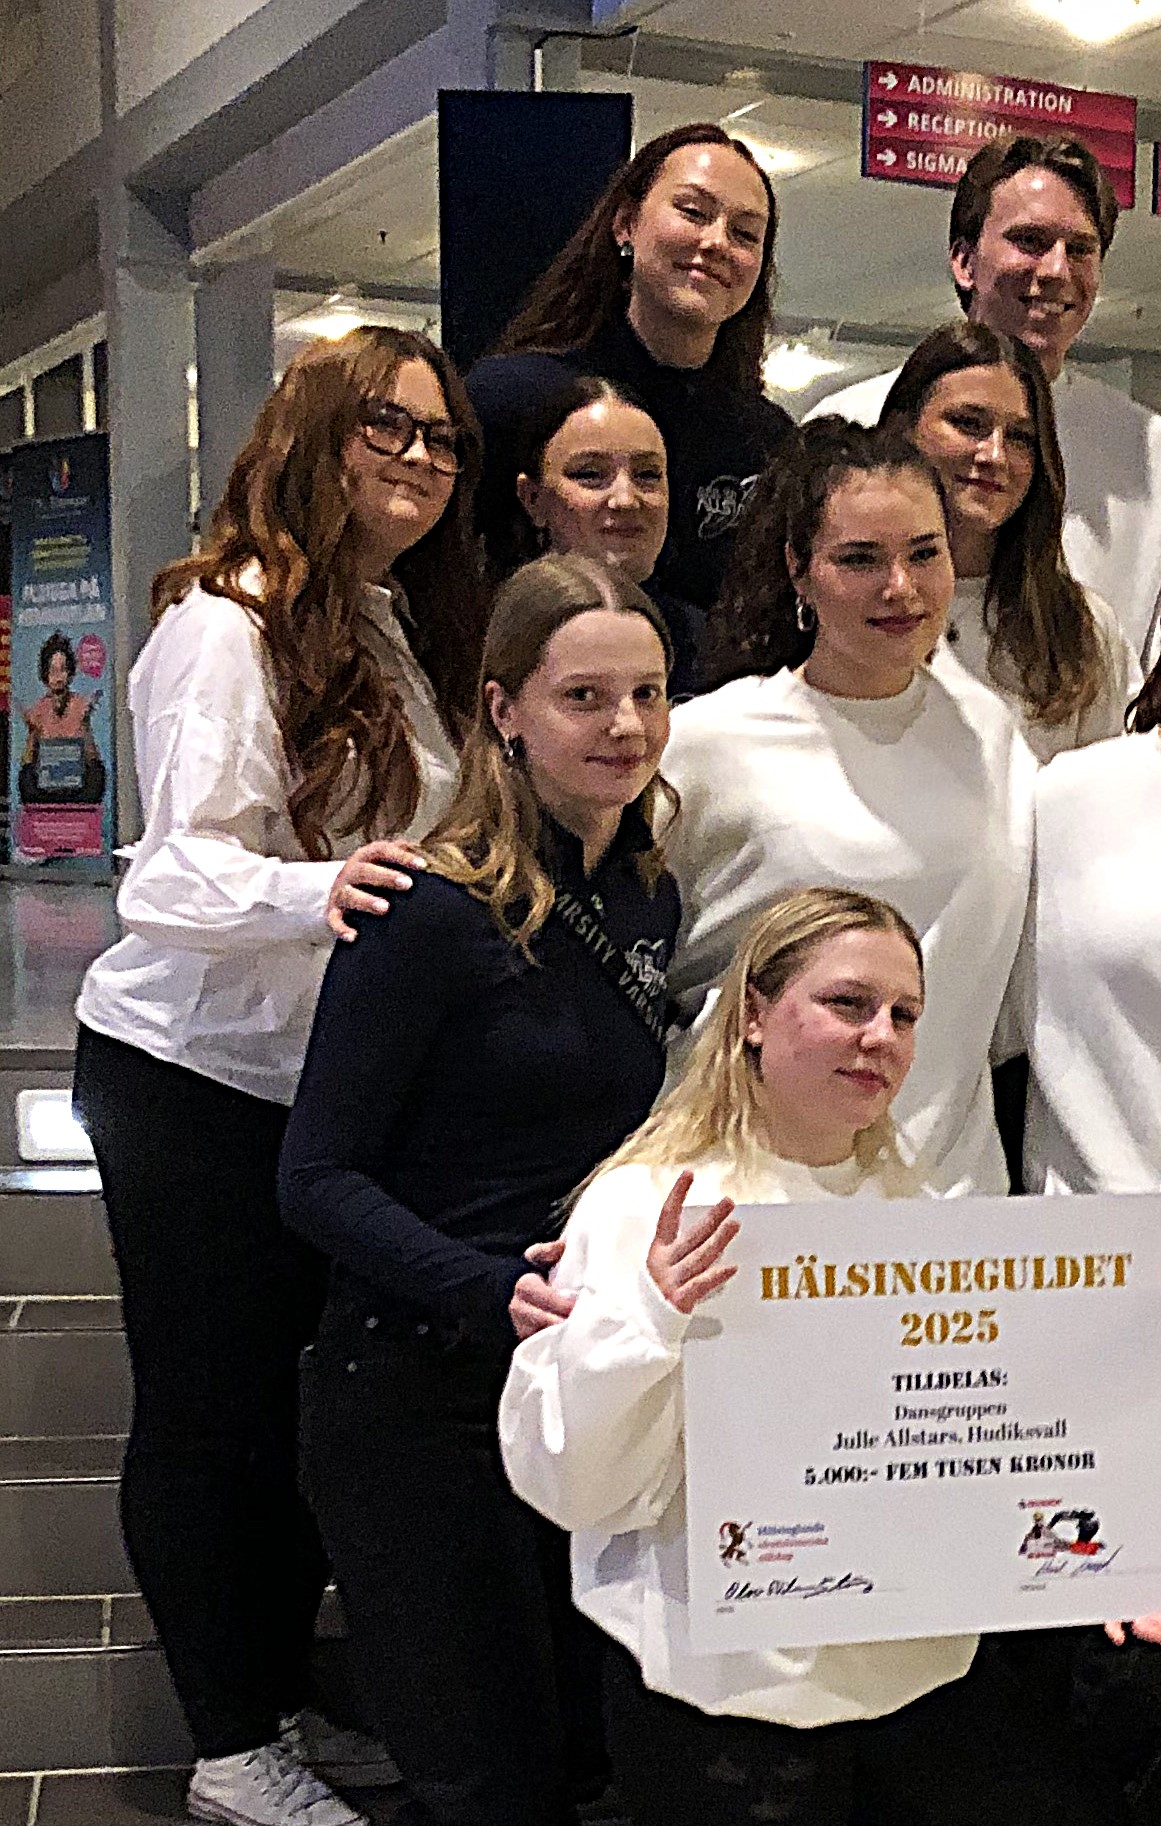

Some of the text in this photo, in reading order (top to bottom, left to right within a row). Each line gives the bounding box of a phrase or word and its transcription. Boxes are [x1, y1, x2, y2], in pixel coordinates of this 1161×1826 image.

[907, 74, 1073, 114] ADMINISTRATION
[760, 1252, 1134, 1301] HÄLSINGEGULDET
[900, 1309, 1000, 1348] 2025
[891, 1368, 1009, 1393] TILLDELAS:
[894, 1402, 1008, 1424] Dansgruppen
[967, 1418, 1068, 1444] Hudiksvall
[885, 1460, 929, 1482] FEM
[934, 1457, 1002, 1479] TUSEN
[1009, 1450, 1096, 1475] KRONOR
